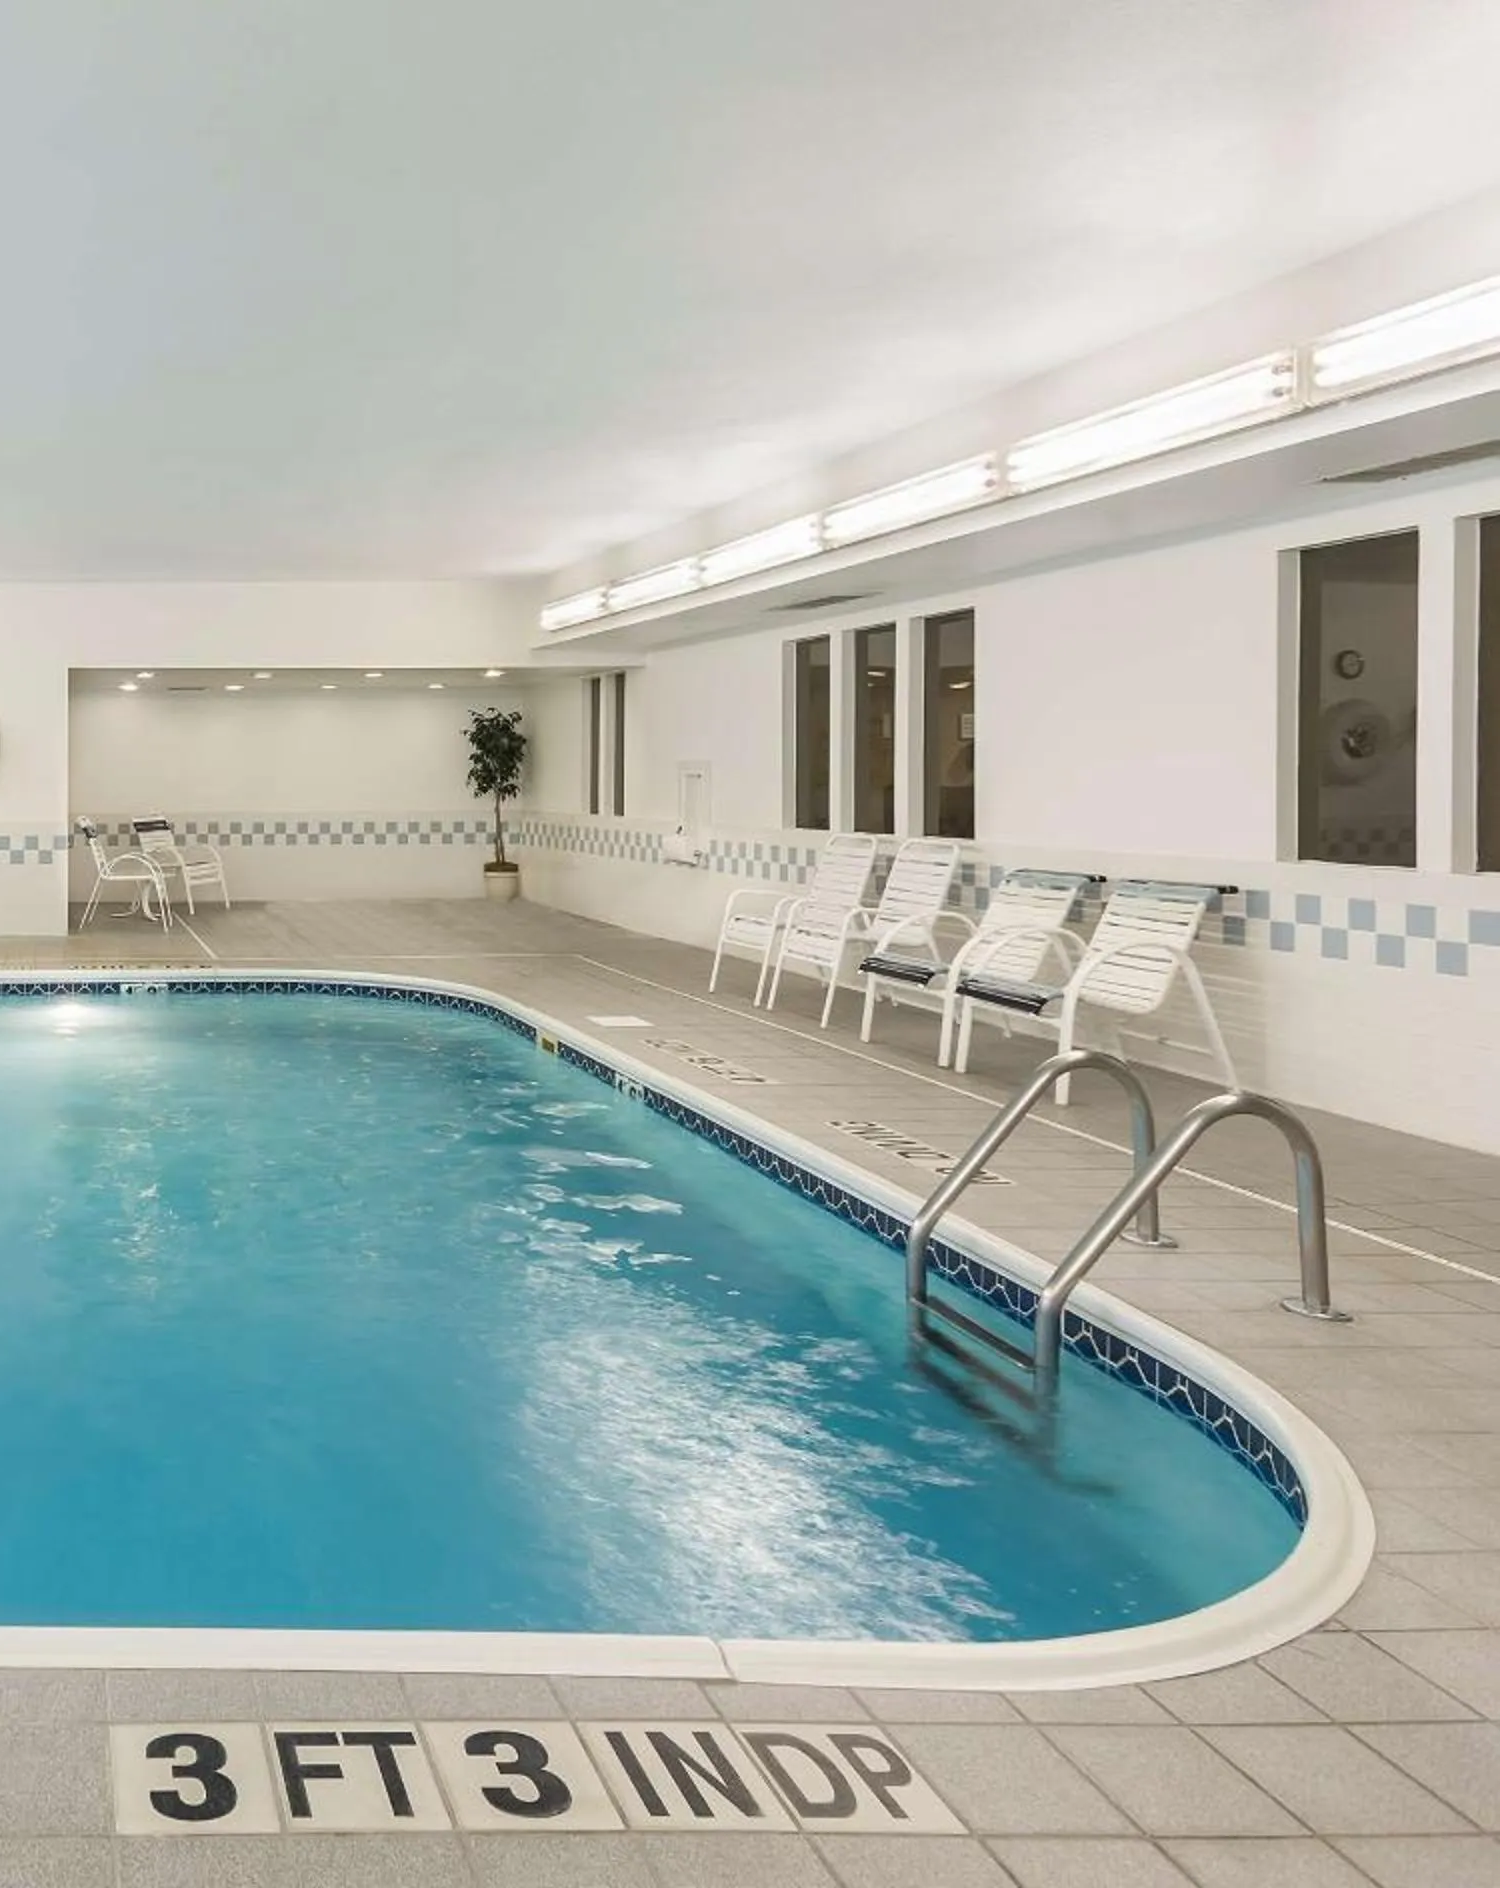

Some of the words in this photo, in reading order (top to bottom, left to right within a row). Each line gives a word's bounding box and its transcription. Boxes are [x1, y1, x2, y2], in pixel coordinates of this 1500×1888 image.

[145, 1731, 238, 1822] 3
[272, 1731, 420, 1819] FT
[462, 1730, 573, 1819] 3
